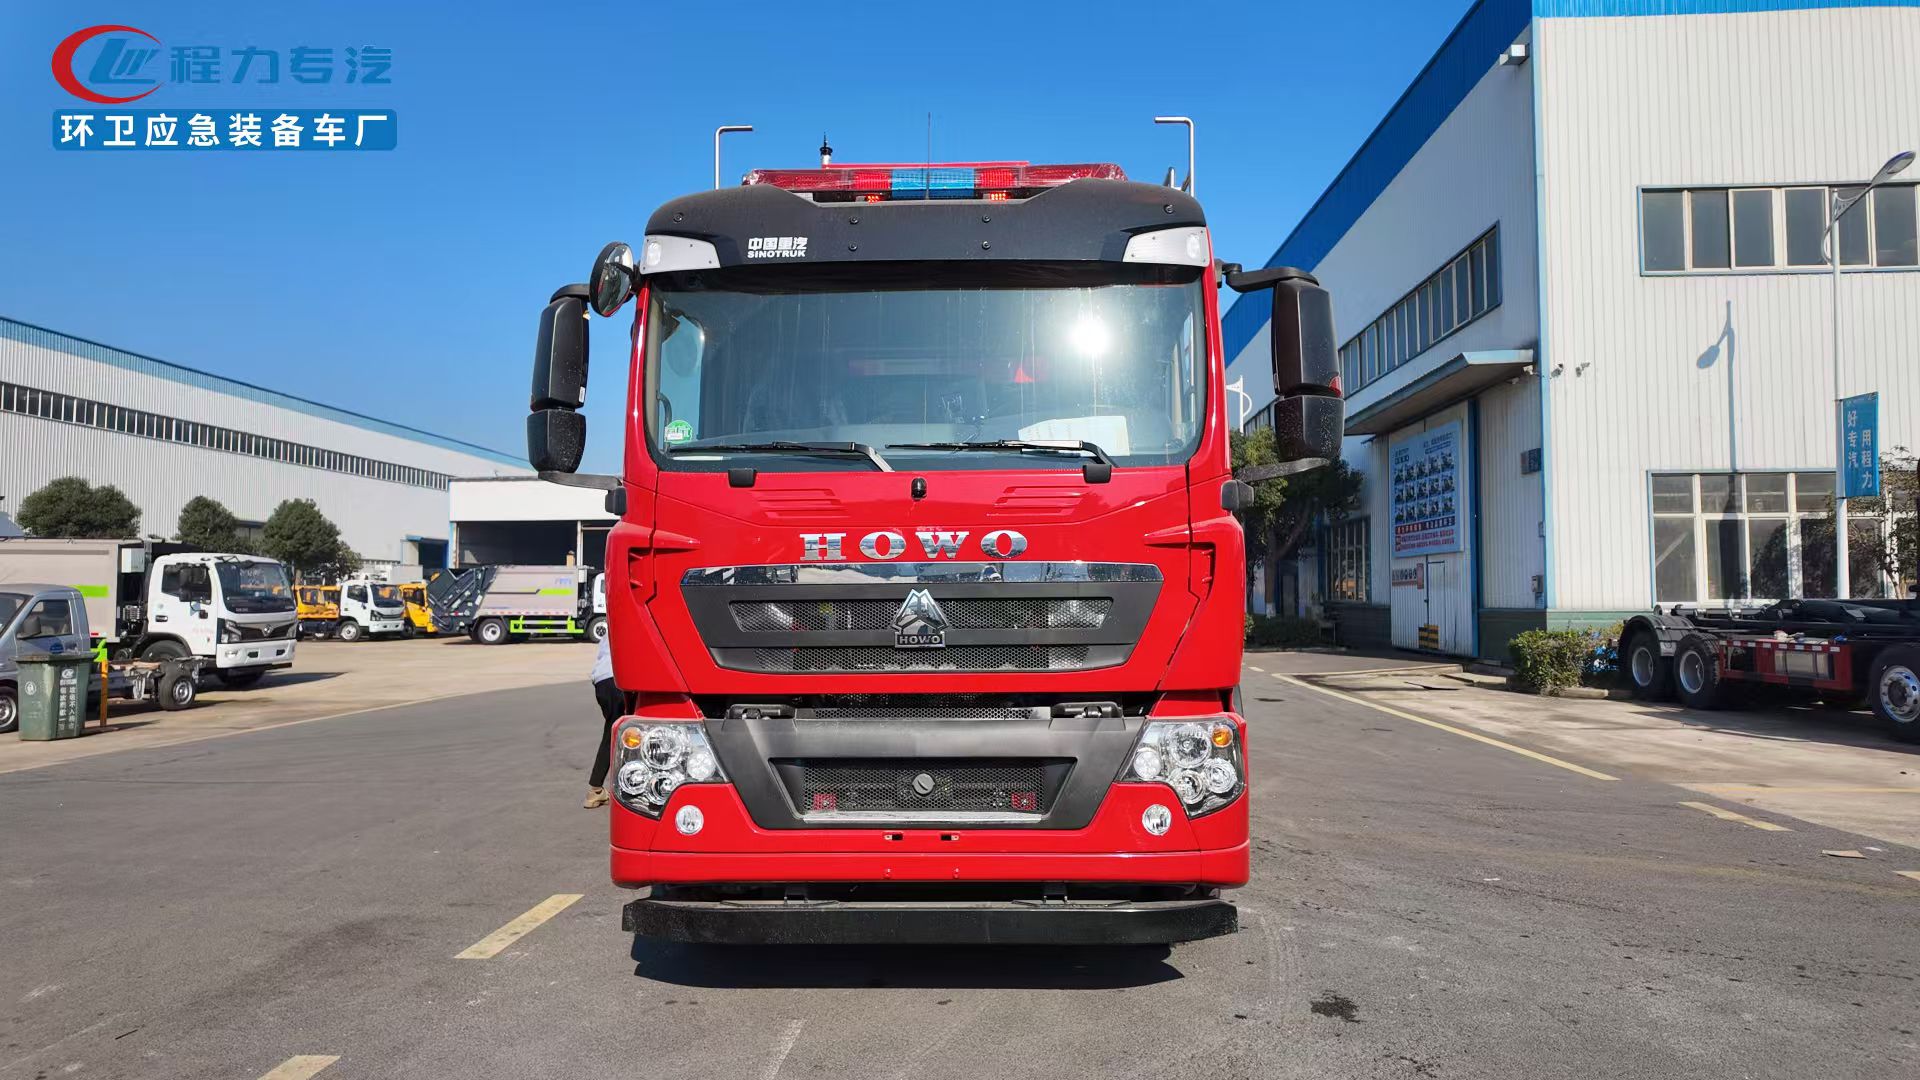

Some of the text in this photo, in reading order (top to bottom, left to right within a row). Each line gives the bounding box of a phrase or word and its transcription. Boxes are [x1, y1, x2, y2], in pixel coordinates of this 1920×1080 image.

[747, 250, 806, 258] SINOTRUK
[748, 237, 808, 250] 中国重汽
[1847, 410, 1858, 468] 好专汽
[1862, 429, 1872, 489] 用程力
[799, 530, 1028, 561] HOWO
[899, 635, 941, 645] HOWO
